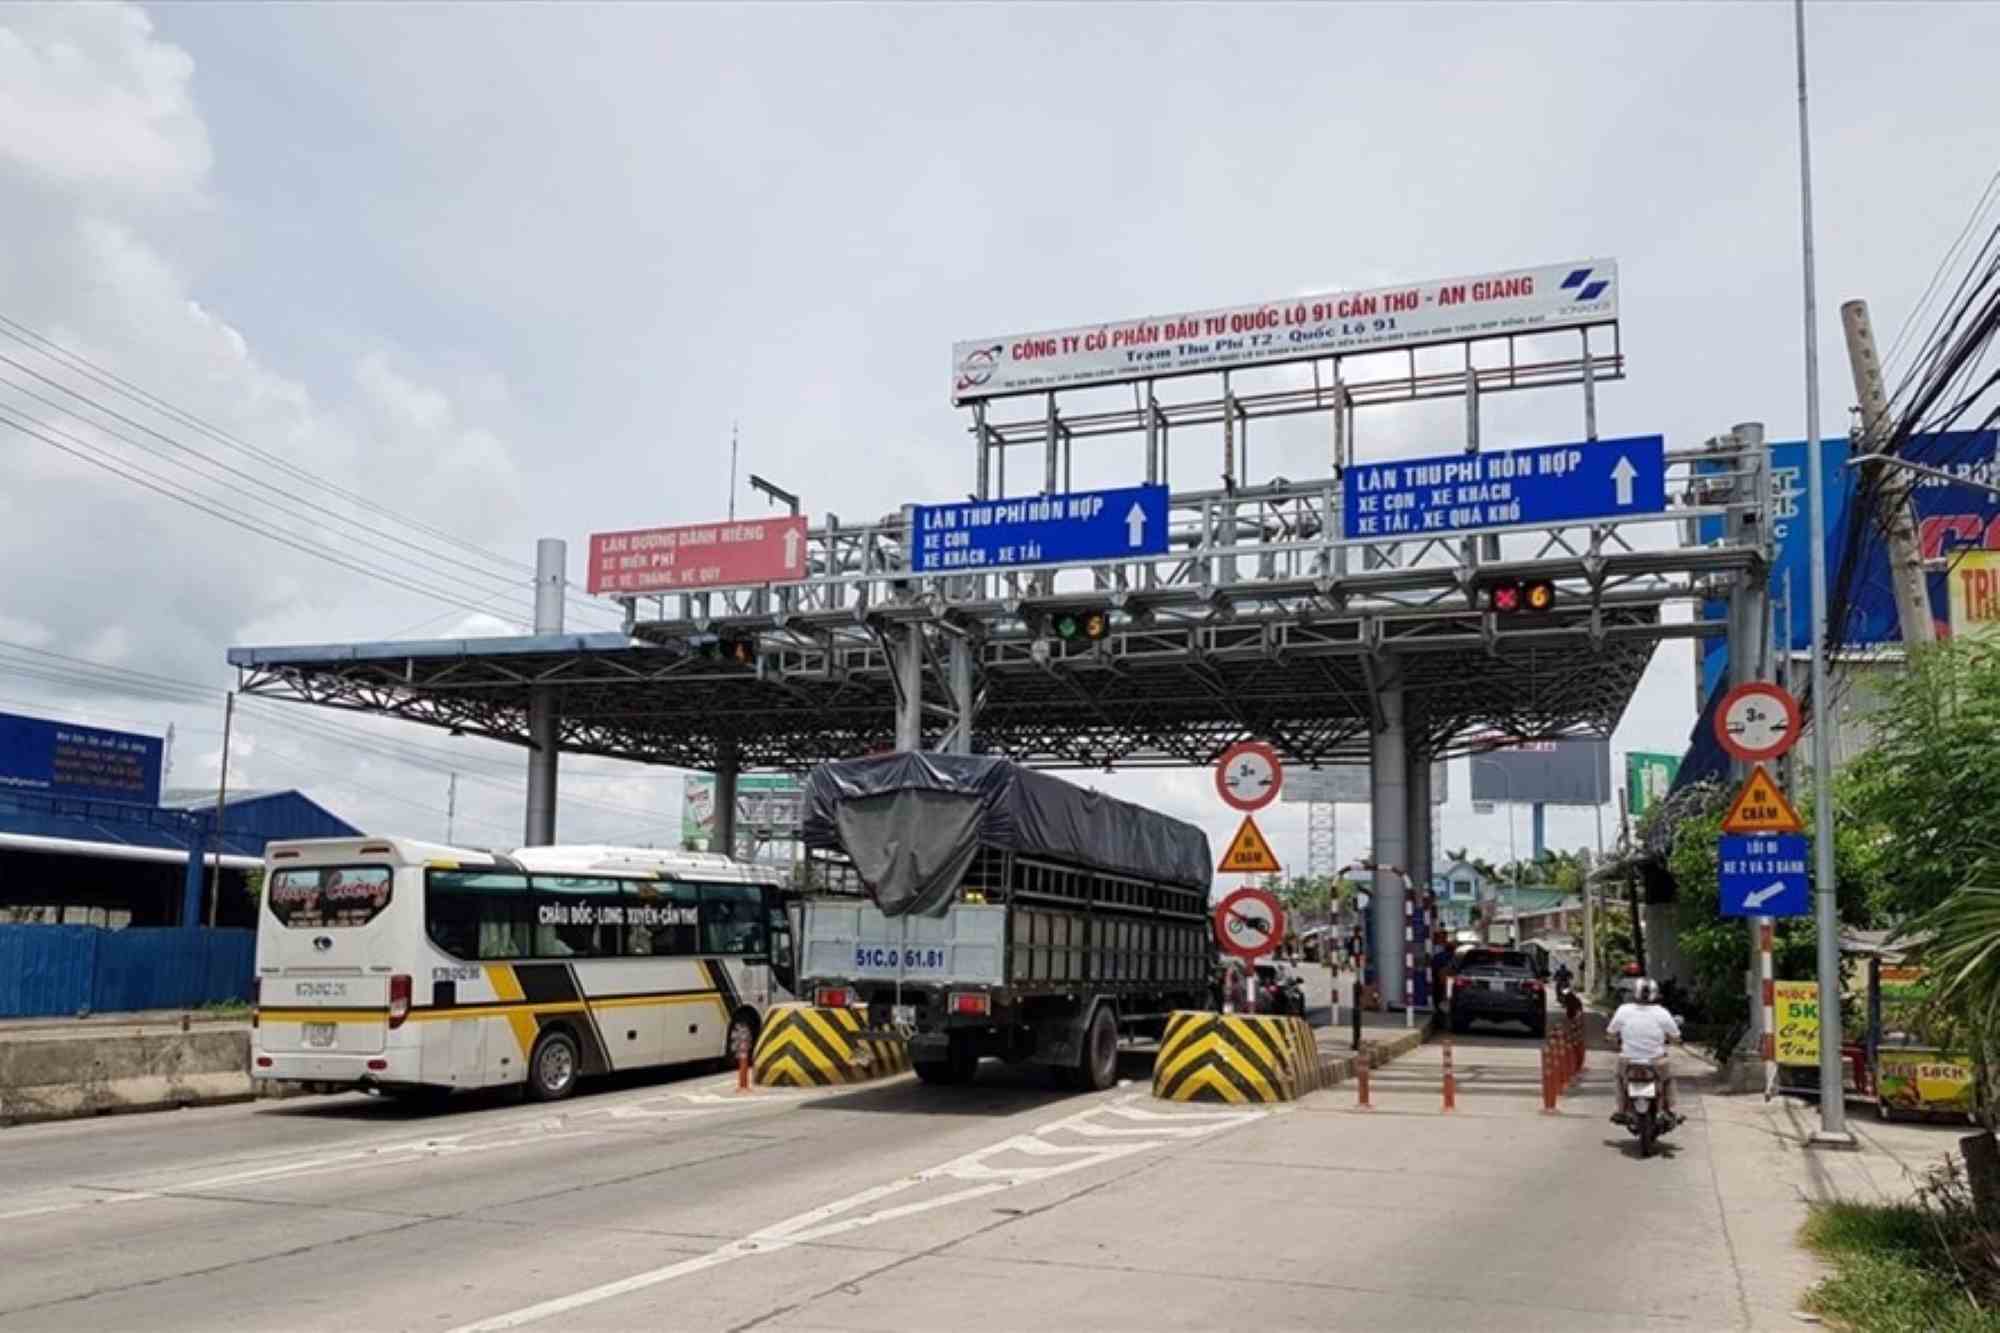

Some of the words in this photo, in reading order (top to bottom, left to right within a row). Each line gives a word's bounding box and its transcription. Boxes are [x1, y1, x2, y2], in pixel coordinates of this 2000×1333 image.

[1012, 338, 1056, 361] CÔNG
[1062, 335, 1081, 355] TY
[1112, 321, 1159, 348] PHẦN
[1164, 315, 1199, 341] ĐẦU
[1205, 313, 1227, 336] TƯ
[1231, 304, 1279, 334] QUỐC
[1285, 302, 1306, 327] LỘ
[1312, 303, 1332, 322] 91
[1339, 291, 1376, 318] CẦN
[1383, 288, 1420, 313] THƠ
[1439, 285, 1466, 306] AN
[1473, 276, 1534, 302] GIANG
[1179, 344, 1209, 356] Thu
[1251, 333, 1273, 347] T2
[1288, 325, 1335, 343] Quốc
[1373, 317, 1396, 332] 91
[1357, 467, 1397, 492] LÀN
[1404, 465, 1442, 487] THU
[1445, 456, 1482, 483] PHÍ
[1538, 449, 1582, 478] HỢP
[923, 507, 956, 530] LÀN
[962, 506, 993, 528] THU
[994, 501, 1026, 525] PHÍ
[1069, 495, 1104, 521] HỢP
[1358, 495, 1379, 513] XE
[1384, 492, 1415, 510] CON
[1431, 488, 1453, 506] XE
[1358, 517, 1379, 534] XE
[1423, 511, 1445, 528] XE
[923, 532, 941, 549] XE
[944, 532, 971, 548] CON
[923, 551, 941, 568] XE
[998, 547, 1017, 563] XE
